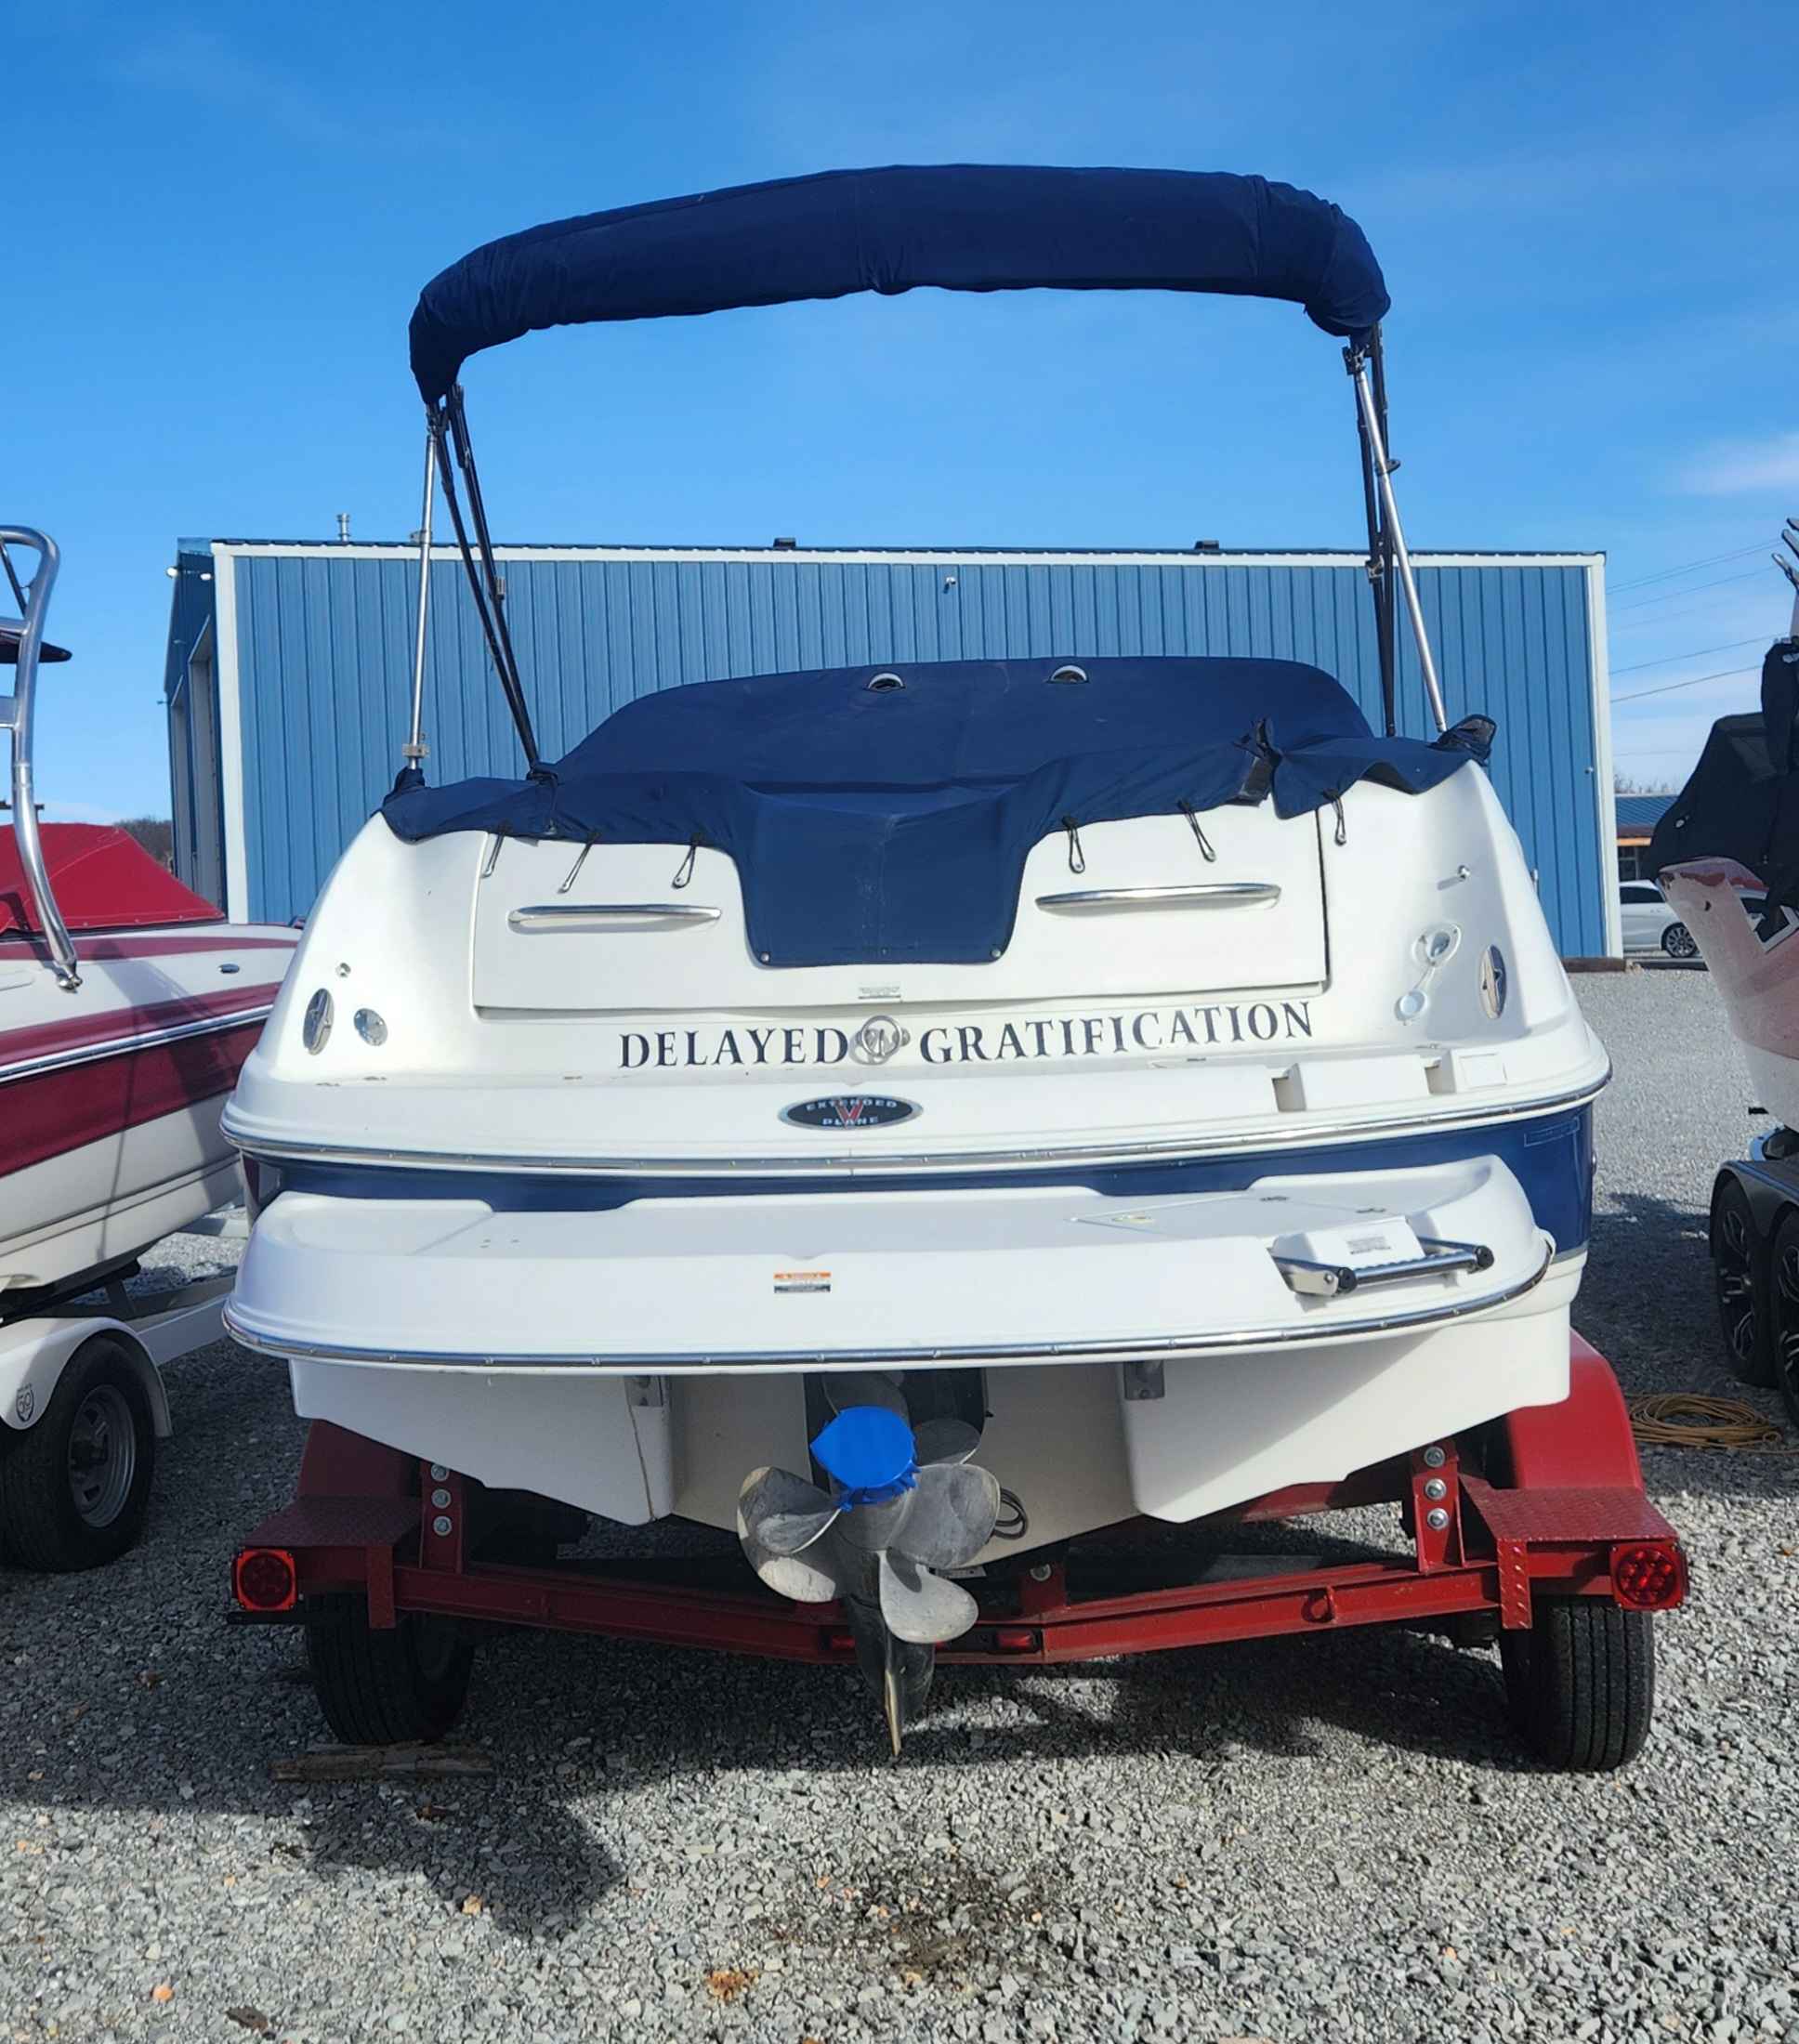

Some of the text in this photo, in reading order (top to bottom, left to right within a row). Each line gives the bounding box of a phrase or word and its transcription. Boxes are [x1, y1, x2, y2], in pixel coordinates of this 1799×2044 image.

[618, 1001, 1313, 1068] DELAYED GRATIFICATION
[805, 1096, 899, 1112] EXTENDED
[821, 1116, 879, 1127] PLANE
